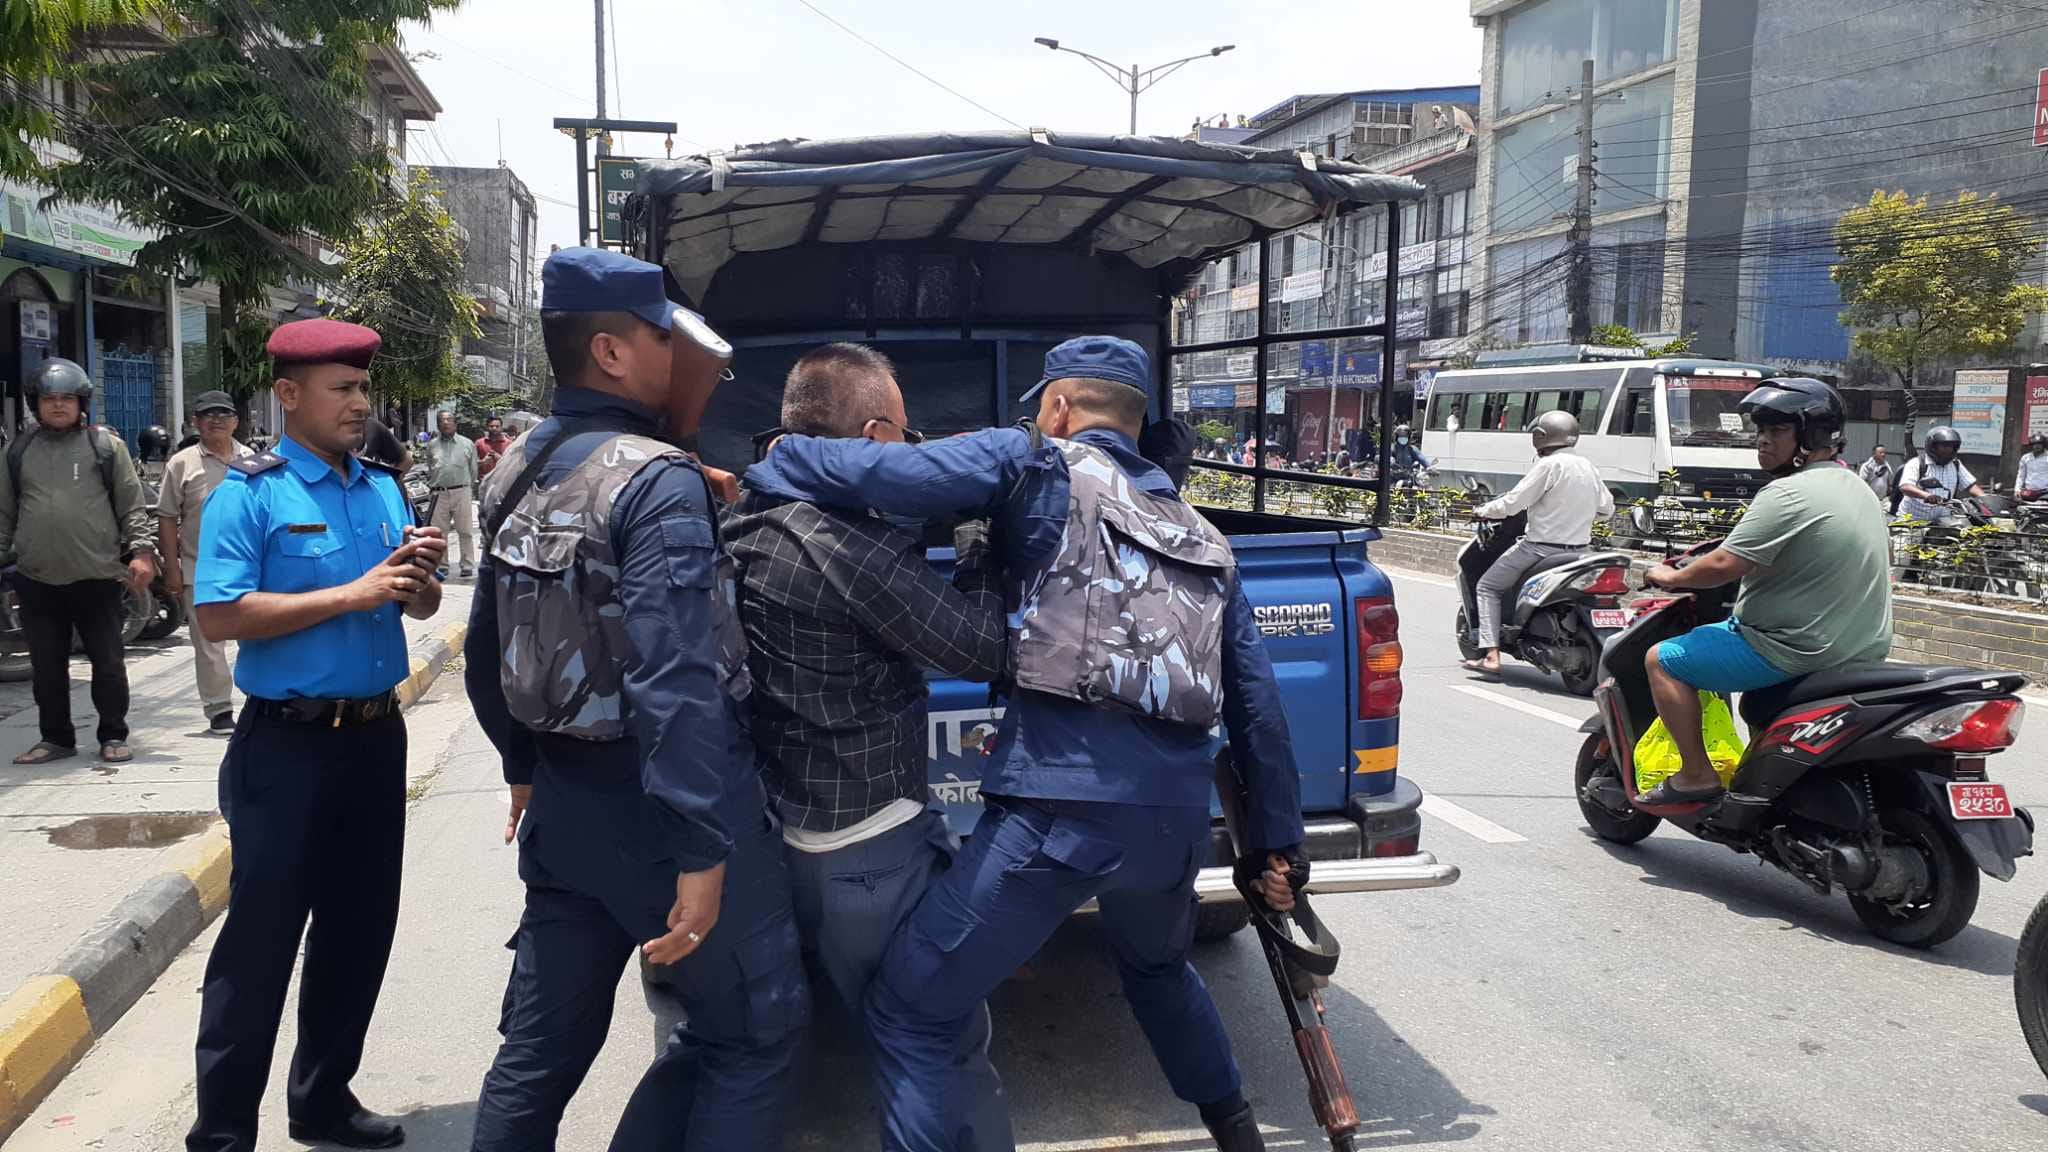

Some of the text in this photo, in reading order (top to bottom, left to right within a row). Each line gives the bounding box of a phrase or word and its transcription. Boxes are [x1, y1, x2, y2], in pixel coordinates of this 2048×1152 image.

[1253, 603, 1332, 626] SCORPIO
[1261, 623, 1335, 637] PIK UP
[1960, 798, 2004, 813] २५३८
